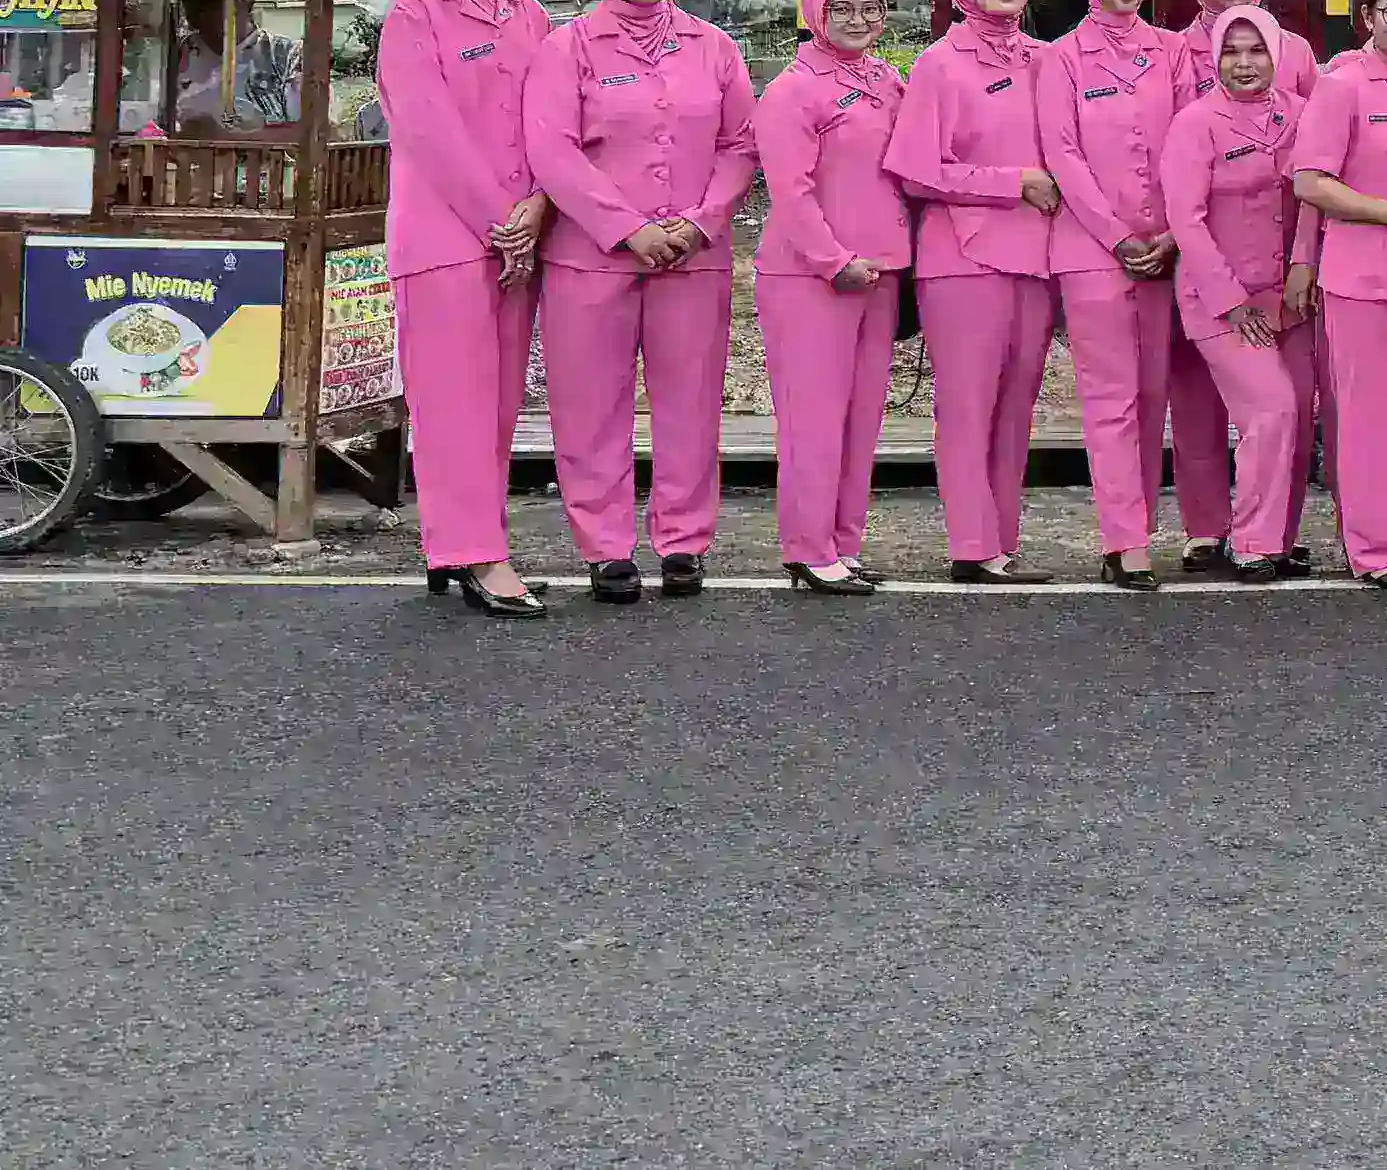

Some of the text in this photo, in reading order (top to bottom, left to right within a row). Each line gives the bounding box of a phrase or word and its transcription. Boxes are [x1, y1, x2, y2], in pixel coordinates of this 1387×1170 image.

[85, 271, 218, 305] Mie Nyemek
[73, 365, 99, 381] 10K
